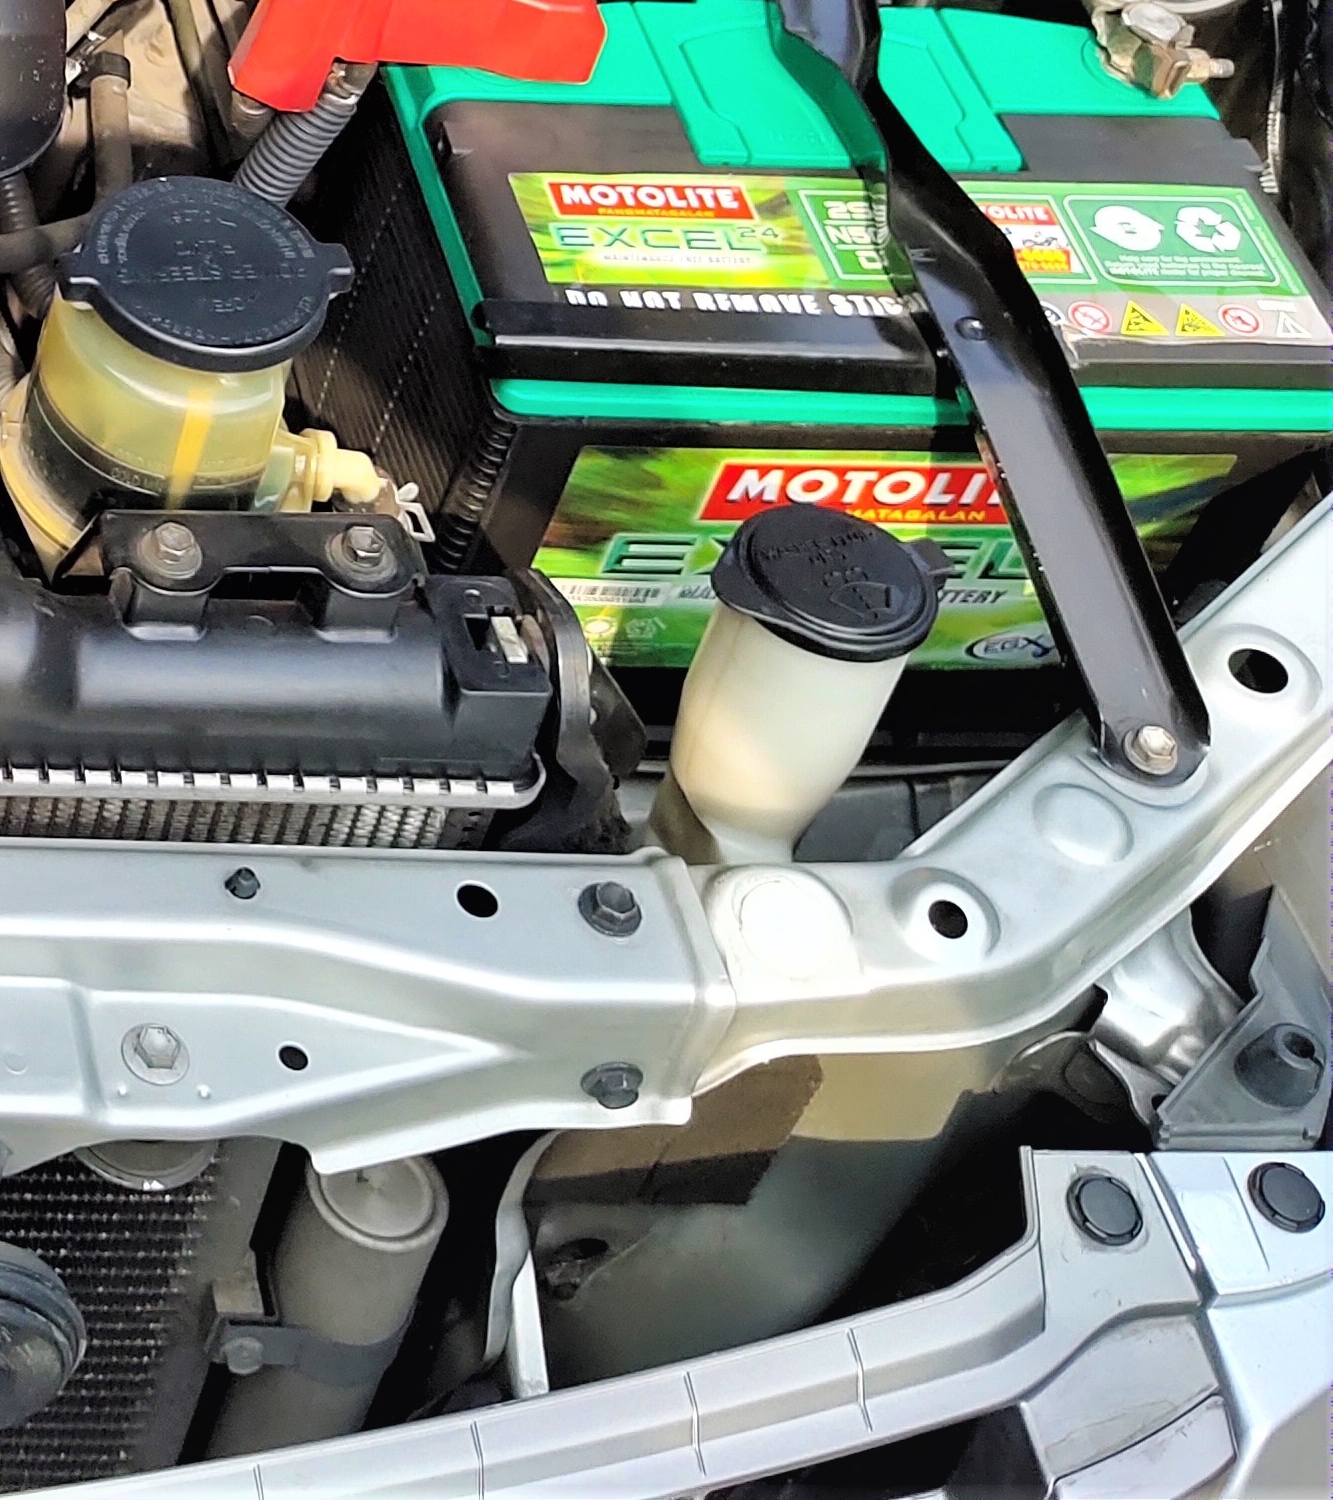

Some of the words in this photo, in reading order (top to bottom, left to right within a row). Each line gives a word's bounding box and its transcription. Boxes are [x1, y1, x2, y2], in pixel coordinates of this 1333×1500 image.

[560, 185, 739, 209] MOTOLITE
[979, 206, 1049, 220] OLITE
[554, 226, 763, 251] EXCEL
[737, 227, 780, 239] 24
[565, 289, 608, 307] DO
[619, 290, 681, 310] NOT
[692, 292, 822, 315] REMOVE
[828, 294, 904, 316] STIC
[726, 468, 999, 504] MOTOLI
[846, 508, 985, 522] MATAGALAN
[938, 590, 1008, 604] TTERY
